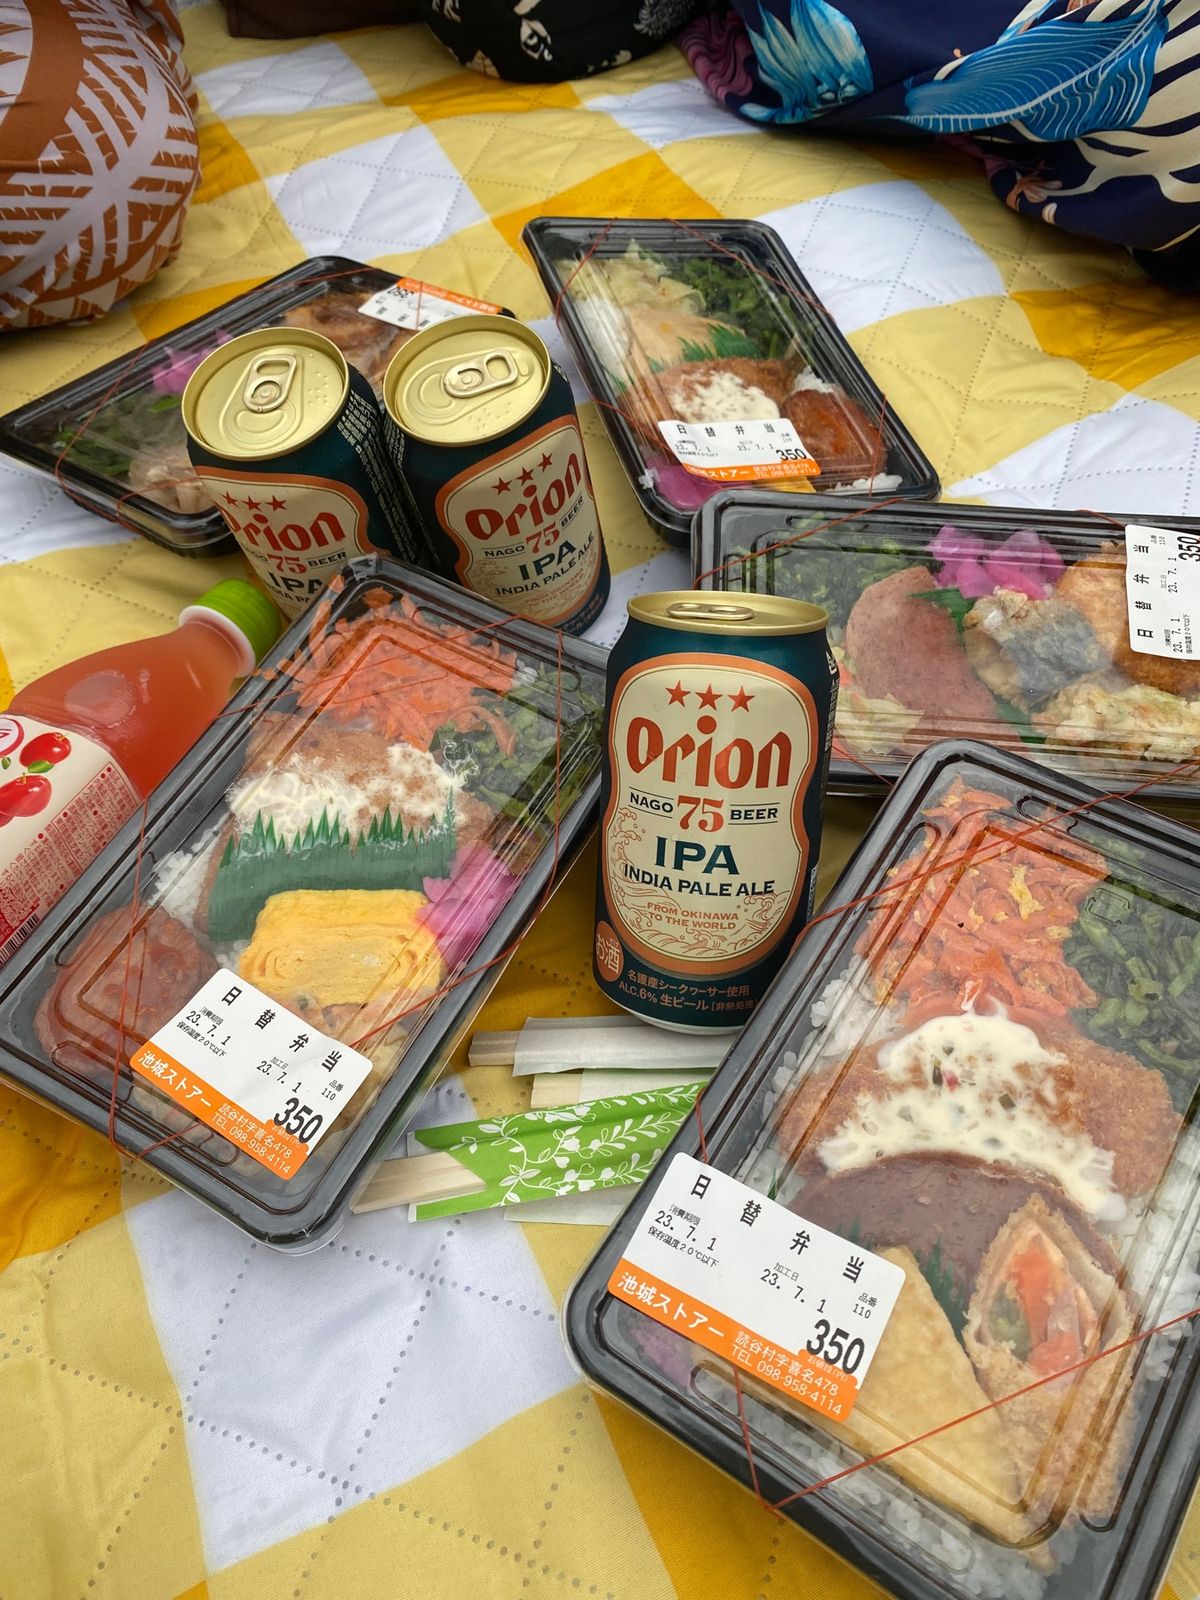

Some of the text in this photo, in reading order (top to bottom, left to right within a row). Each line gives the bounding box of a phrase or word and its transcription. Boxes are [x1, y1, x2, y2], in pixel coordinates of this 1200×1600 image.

[775, 448, 807, 461] 350
[464, 452, 582, 541] Orion
[484, 496, 584, 558] NAGO 75 BEER
[267, 551, 347, 575] 75 BEER
[496, 531, 595, 596] INDIA PALE ALE
[518, 540, 577, 581] IPA
[1177, 535, 1200, 562] 350
[626, 714, 792, 790] Orion
[630, 792, 779, 833] NAGO 75 BEER
[655, 835, 740, 876] IPA
[623, 863, 775, 897] INDIA PALE ALE
[647, 901, 739, 921] FROM OKINAWA
[649, 911, 737, 930] TO THE WORLD
[659, 993, 710, 1012] 生ビール
[221, 986, 342, 1073] 日替弁当
[138, 1050, 212, 1109] 池城ストアー
[270, 1056, 289, 1070] 加工日
[321, 1087, 336, 1101] 110
[329, 1079, 344, 1093] 品番
[273, 1097, 324, 1144] 350
[212, 1114, 291, 1174] TEL 098-958-4114
[690, 1174, 865, 1284] 日替弁当
[773, 1262, 799, 1281] 加工日
[617, 1272, 724, 1339] 池城ストアー
[852, 1303, 872, 1319] 110
[858, 1292, 878, 1308] 品番
[733, 1331, 839, 1397] 読谷村字喜名478
[806, 1318, 865, 1375] 350
[731, 1347, 843, 1416] TEL 098-958-4114
